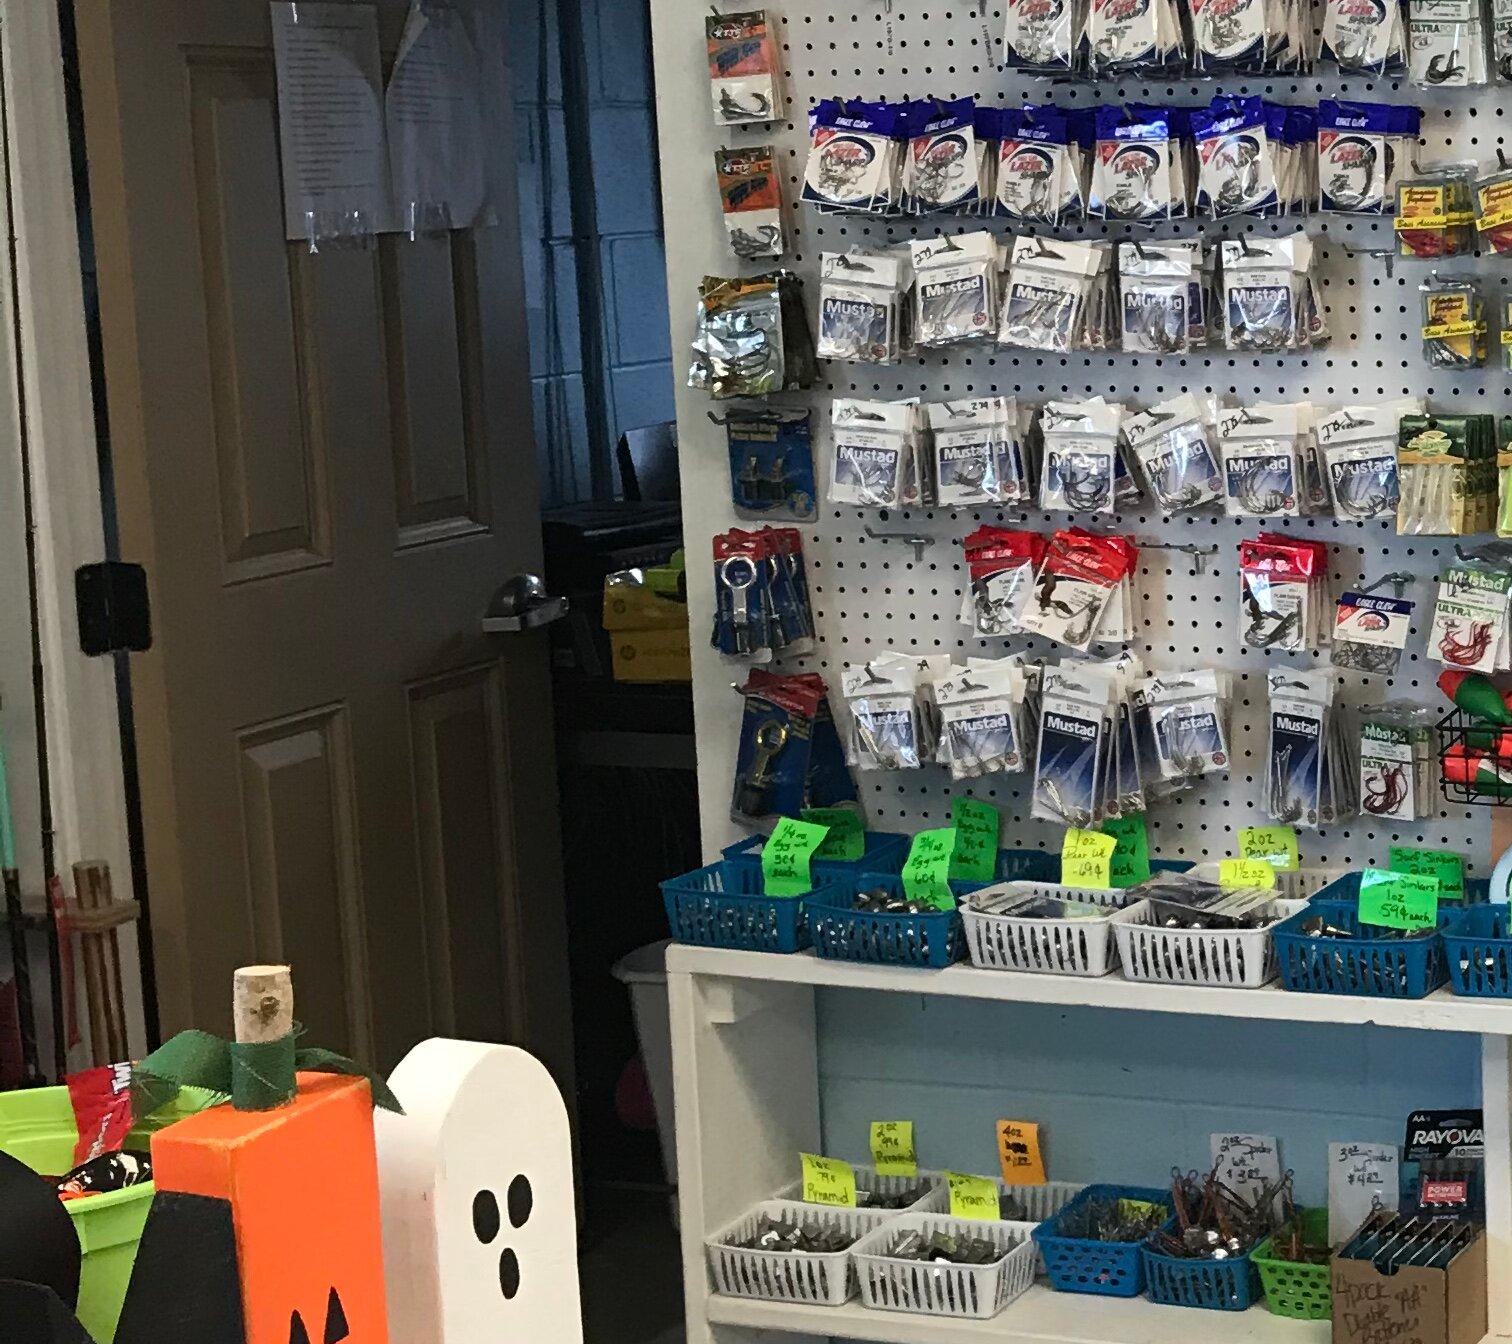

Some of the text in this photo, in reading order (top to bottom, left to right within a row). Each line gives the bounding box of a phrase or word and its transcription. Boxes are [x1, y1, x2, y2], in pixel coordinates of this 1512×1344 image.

[1231, 286, 1287, 303] Mustad
[840, 445, 896, 464] Mustad
[944, 443, 990, 462] Mustad
[953, 714, 1009, 733] Mustad
[1047, 715, 1097, 738] Mustad
[1276, 716, 1319, 736] Mustad
[1398, 876, 1436, 892] Sinkers
[1412, 1128, 1484, 1145] RAYOVA
